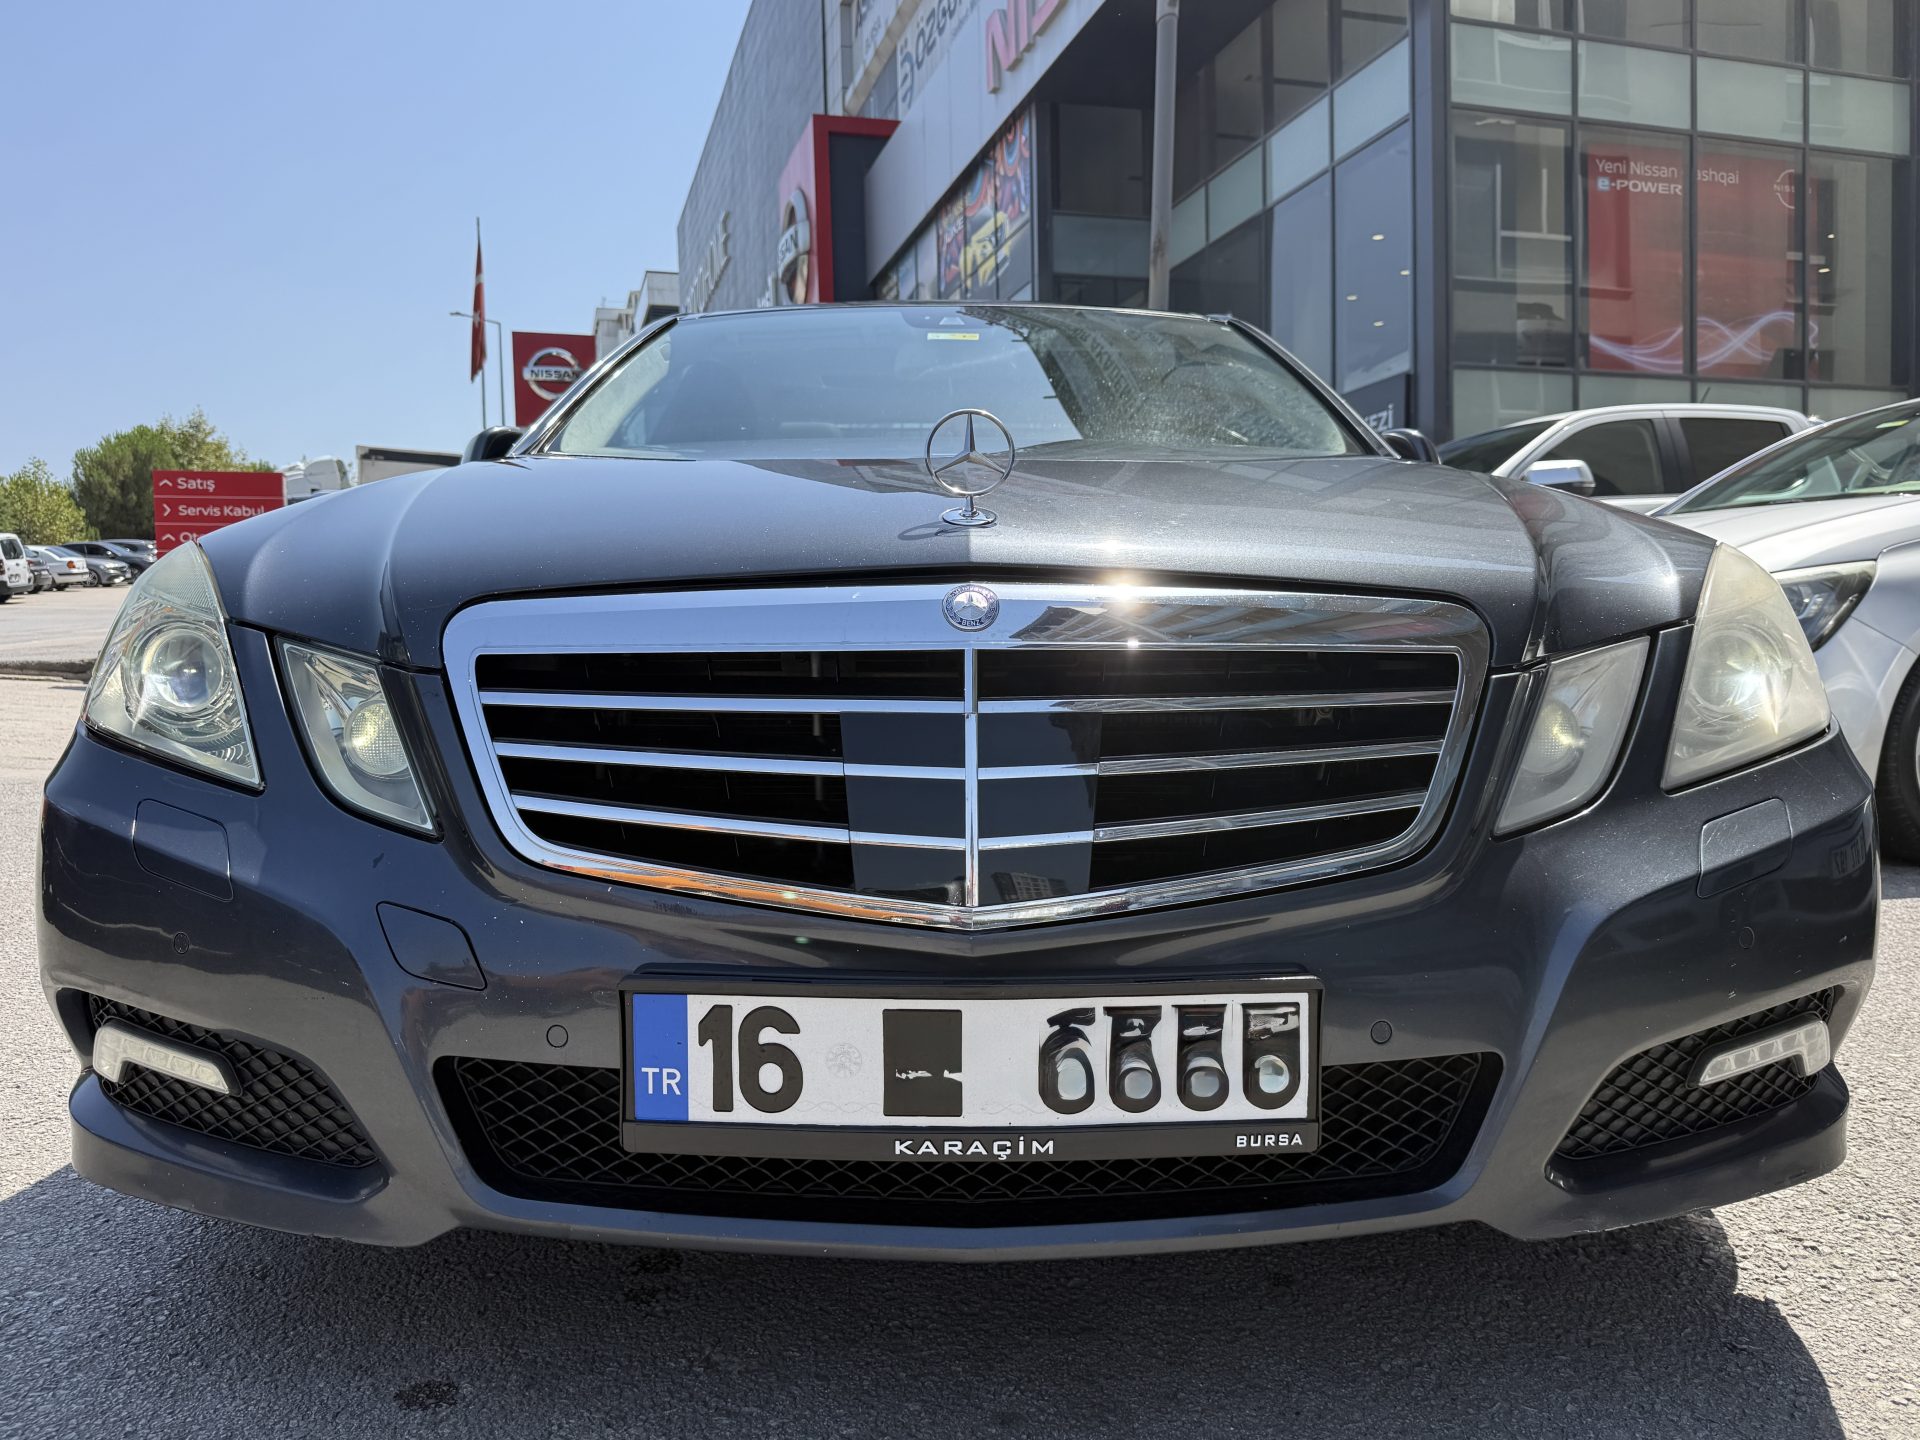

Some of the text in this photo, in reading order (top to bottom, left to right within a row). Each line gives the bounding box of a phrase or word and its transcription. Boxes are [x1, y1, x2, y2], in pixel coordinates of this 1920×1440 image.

[1596, 158, 1626, 174] Yeni
[1630, 161, 1678, 178] Nissan
[177, 477, 215, 492] Satış
[178, 505, 265, 517] Servis Kabul
[961, 618, 981, 627] BENZ
[641, 1067, 681, 1095] TR
[698, 1005, 803, 1114] 16
[894, 1133, 1303, 1160] KARAÇİM BURSA
